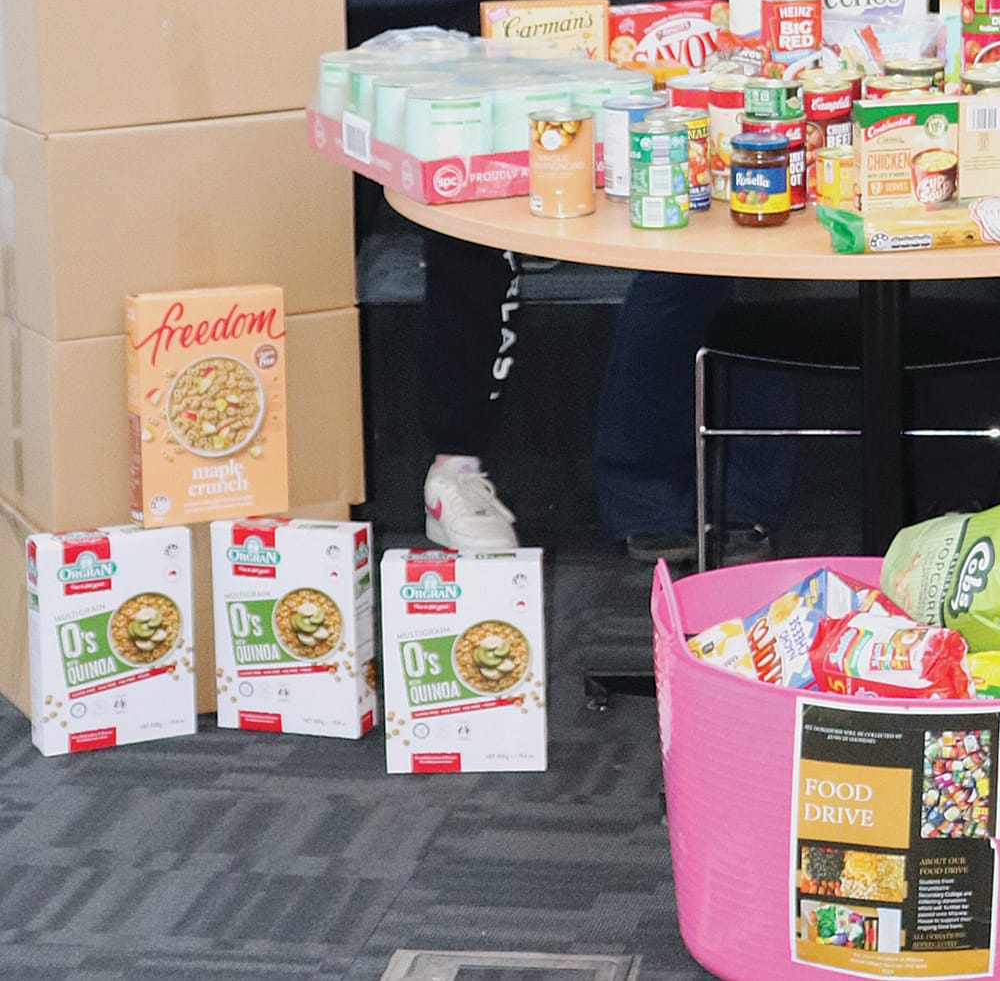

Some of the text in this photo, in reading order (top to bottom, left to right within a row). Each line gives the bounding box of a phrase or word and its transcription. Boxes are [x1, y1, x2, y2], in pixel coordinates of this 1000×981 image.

[779, 6, 814, 19] HEINZ
[502, 11, 594, 40] Carman's
[779, 34, 815, 51] RED
[867, 152, 912, 171] CHICKEN
[128, 302, 287, 367] freedom
[192, 458, 244, 481] maple
[188, 476, 249, 497] crunch
[228, 548, 277, 564] ORGRAN
[59, 562, 113, 581] ORGRAN
[928, 537, 954, 626] POPCORN
[950, 540, 992, 611] Cobs
[402, 585, 457, 599] ORGRAN
[235, 644, 281, 664] QUINOA
[67, 657, 116, 685] QUINOA
[410, 680, 460, 705] QUINOA
[804, 778, 873, 802] FOOD
[803, 803, 875, 827] DRIVE
[920, 867, 943, 875] FOOD
